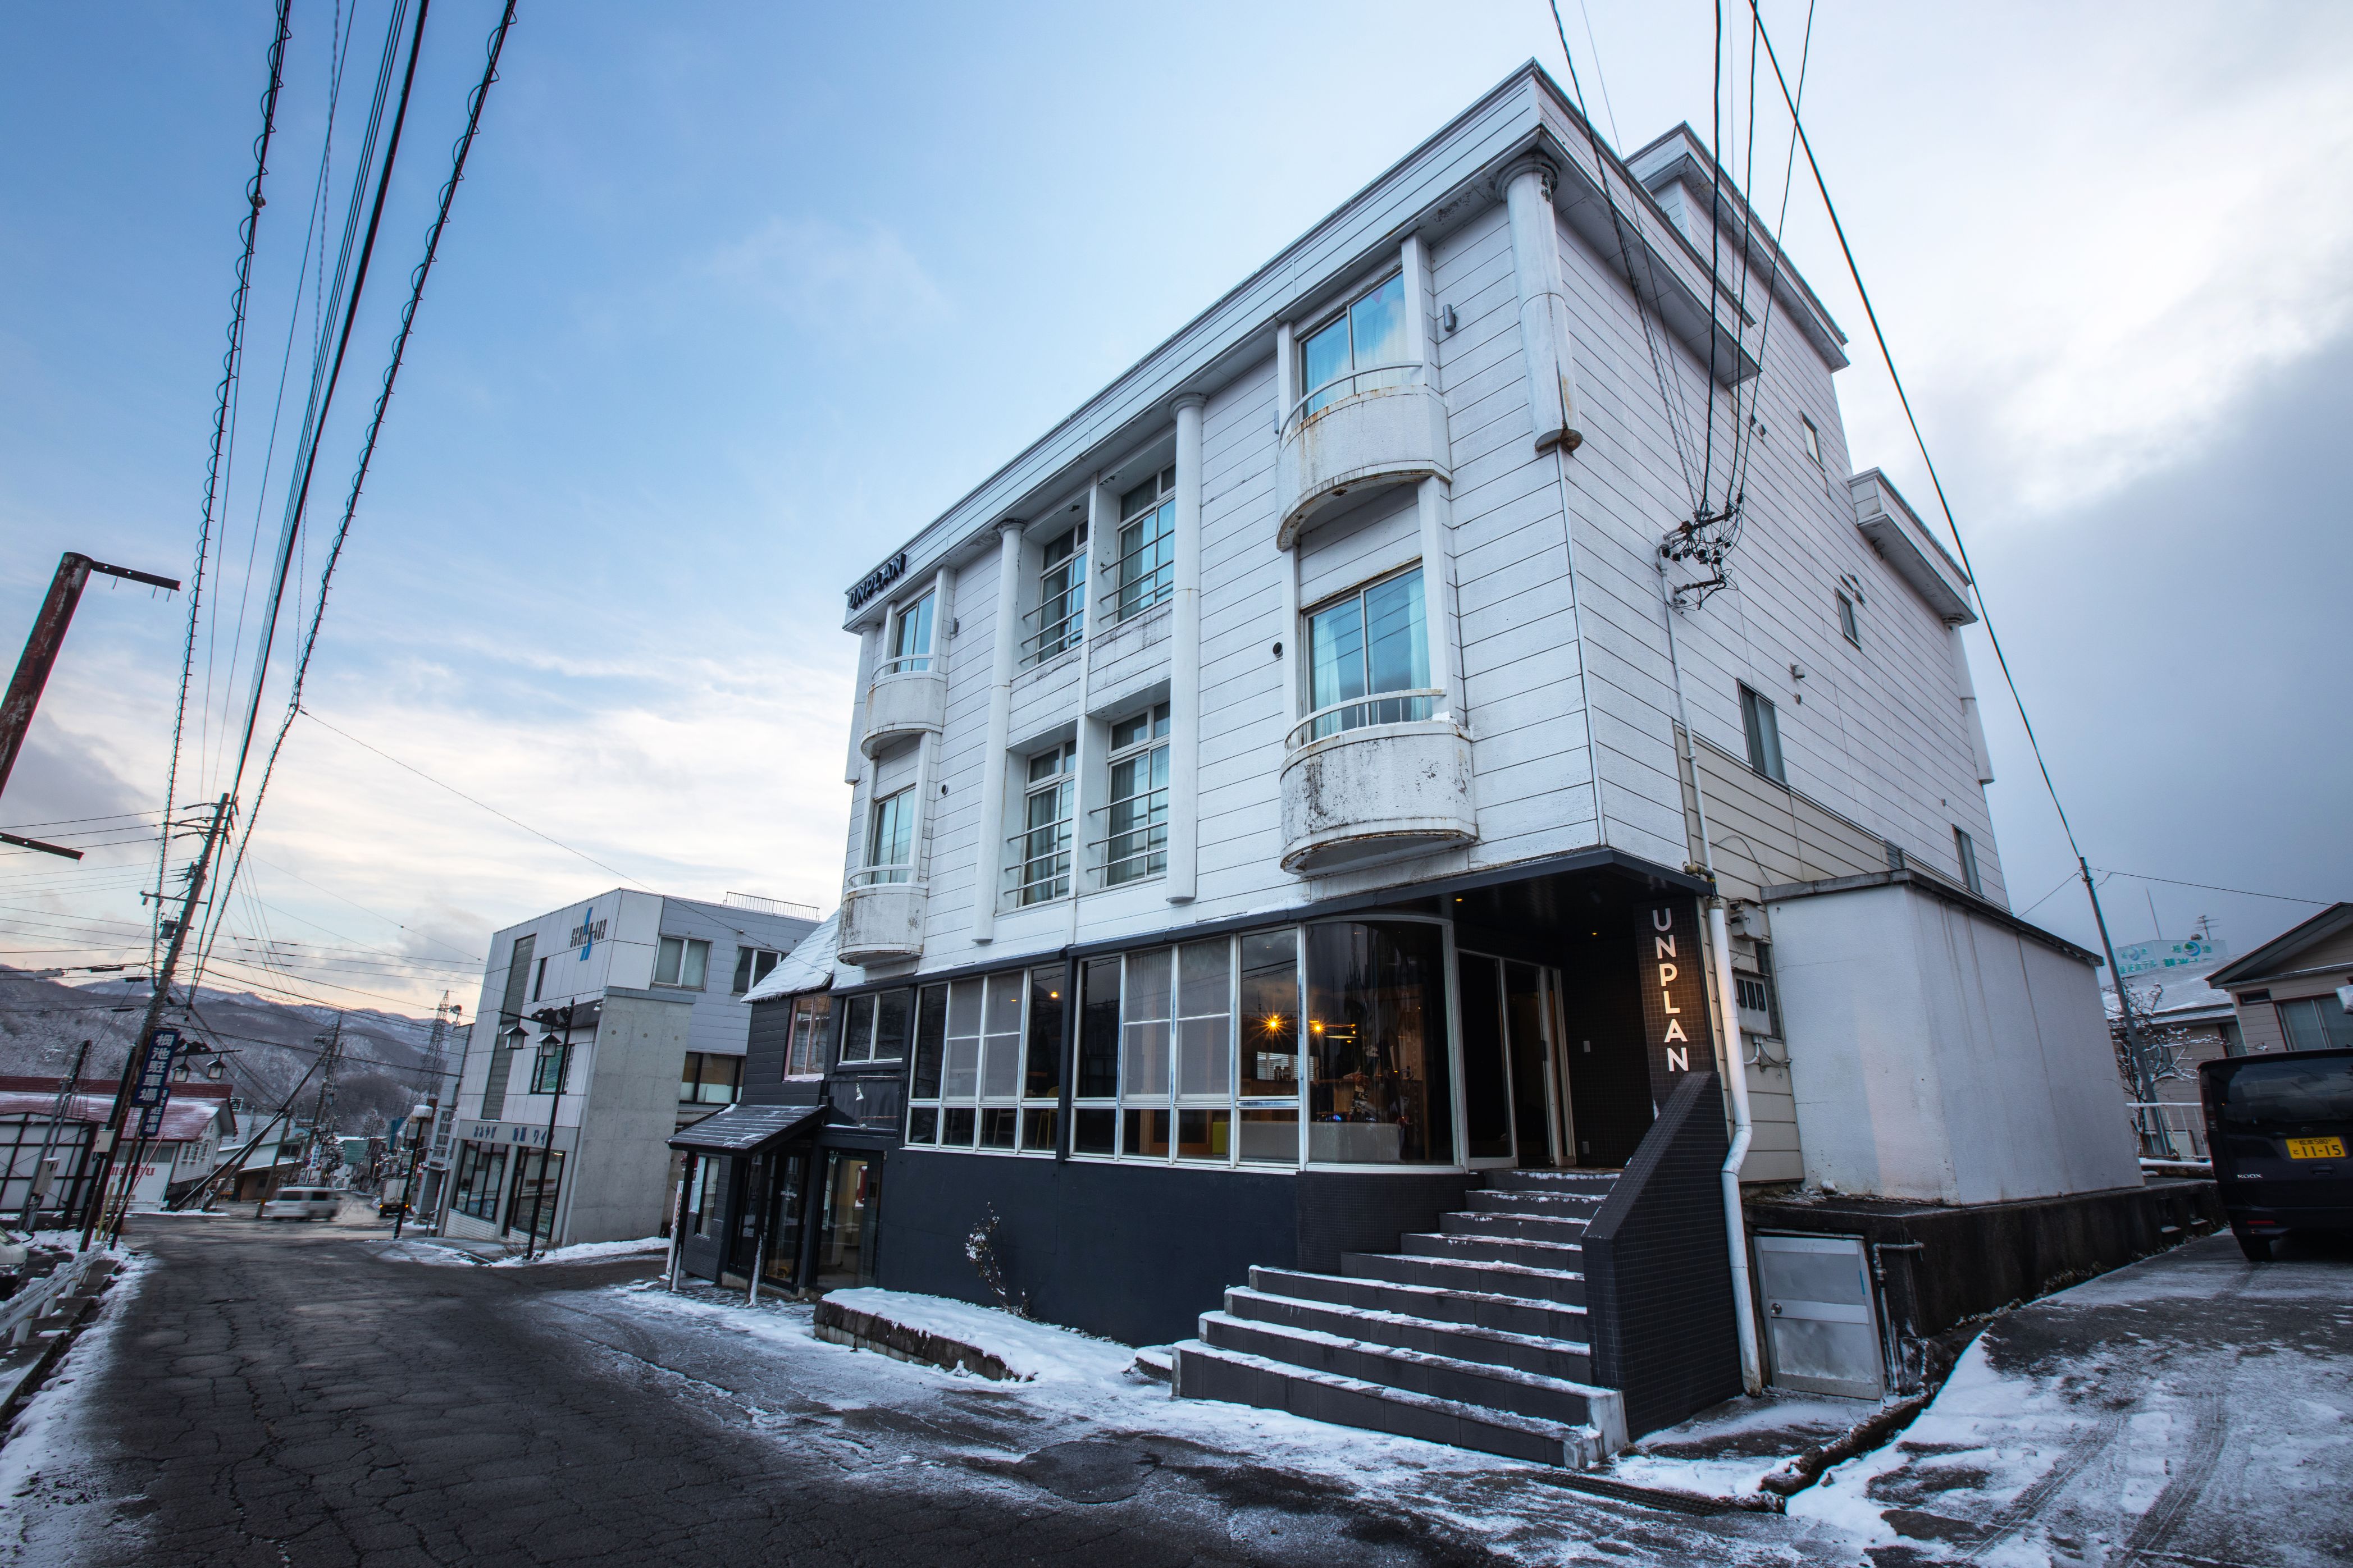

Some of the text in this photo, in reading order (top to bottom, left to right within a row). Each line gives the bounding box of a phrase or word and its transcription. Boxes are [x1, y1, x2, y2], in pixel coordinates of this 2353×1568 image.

[848, 552, 907, 610] UNPLAN
[570, 919, 607, 948] SCREEN-403
[1652, 908, 1689, 1072] UNPLAN
[138, 1034, 174, 1101] 栂池駐車場
